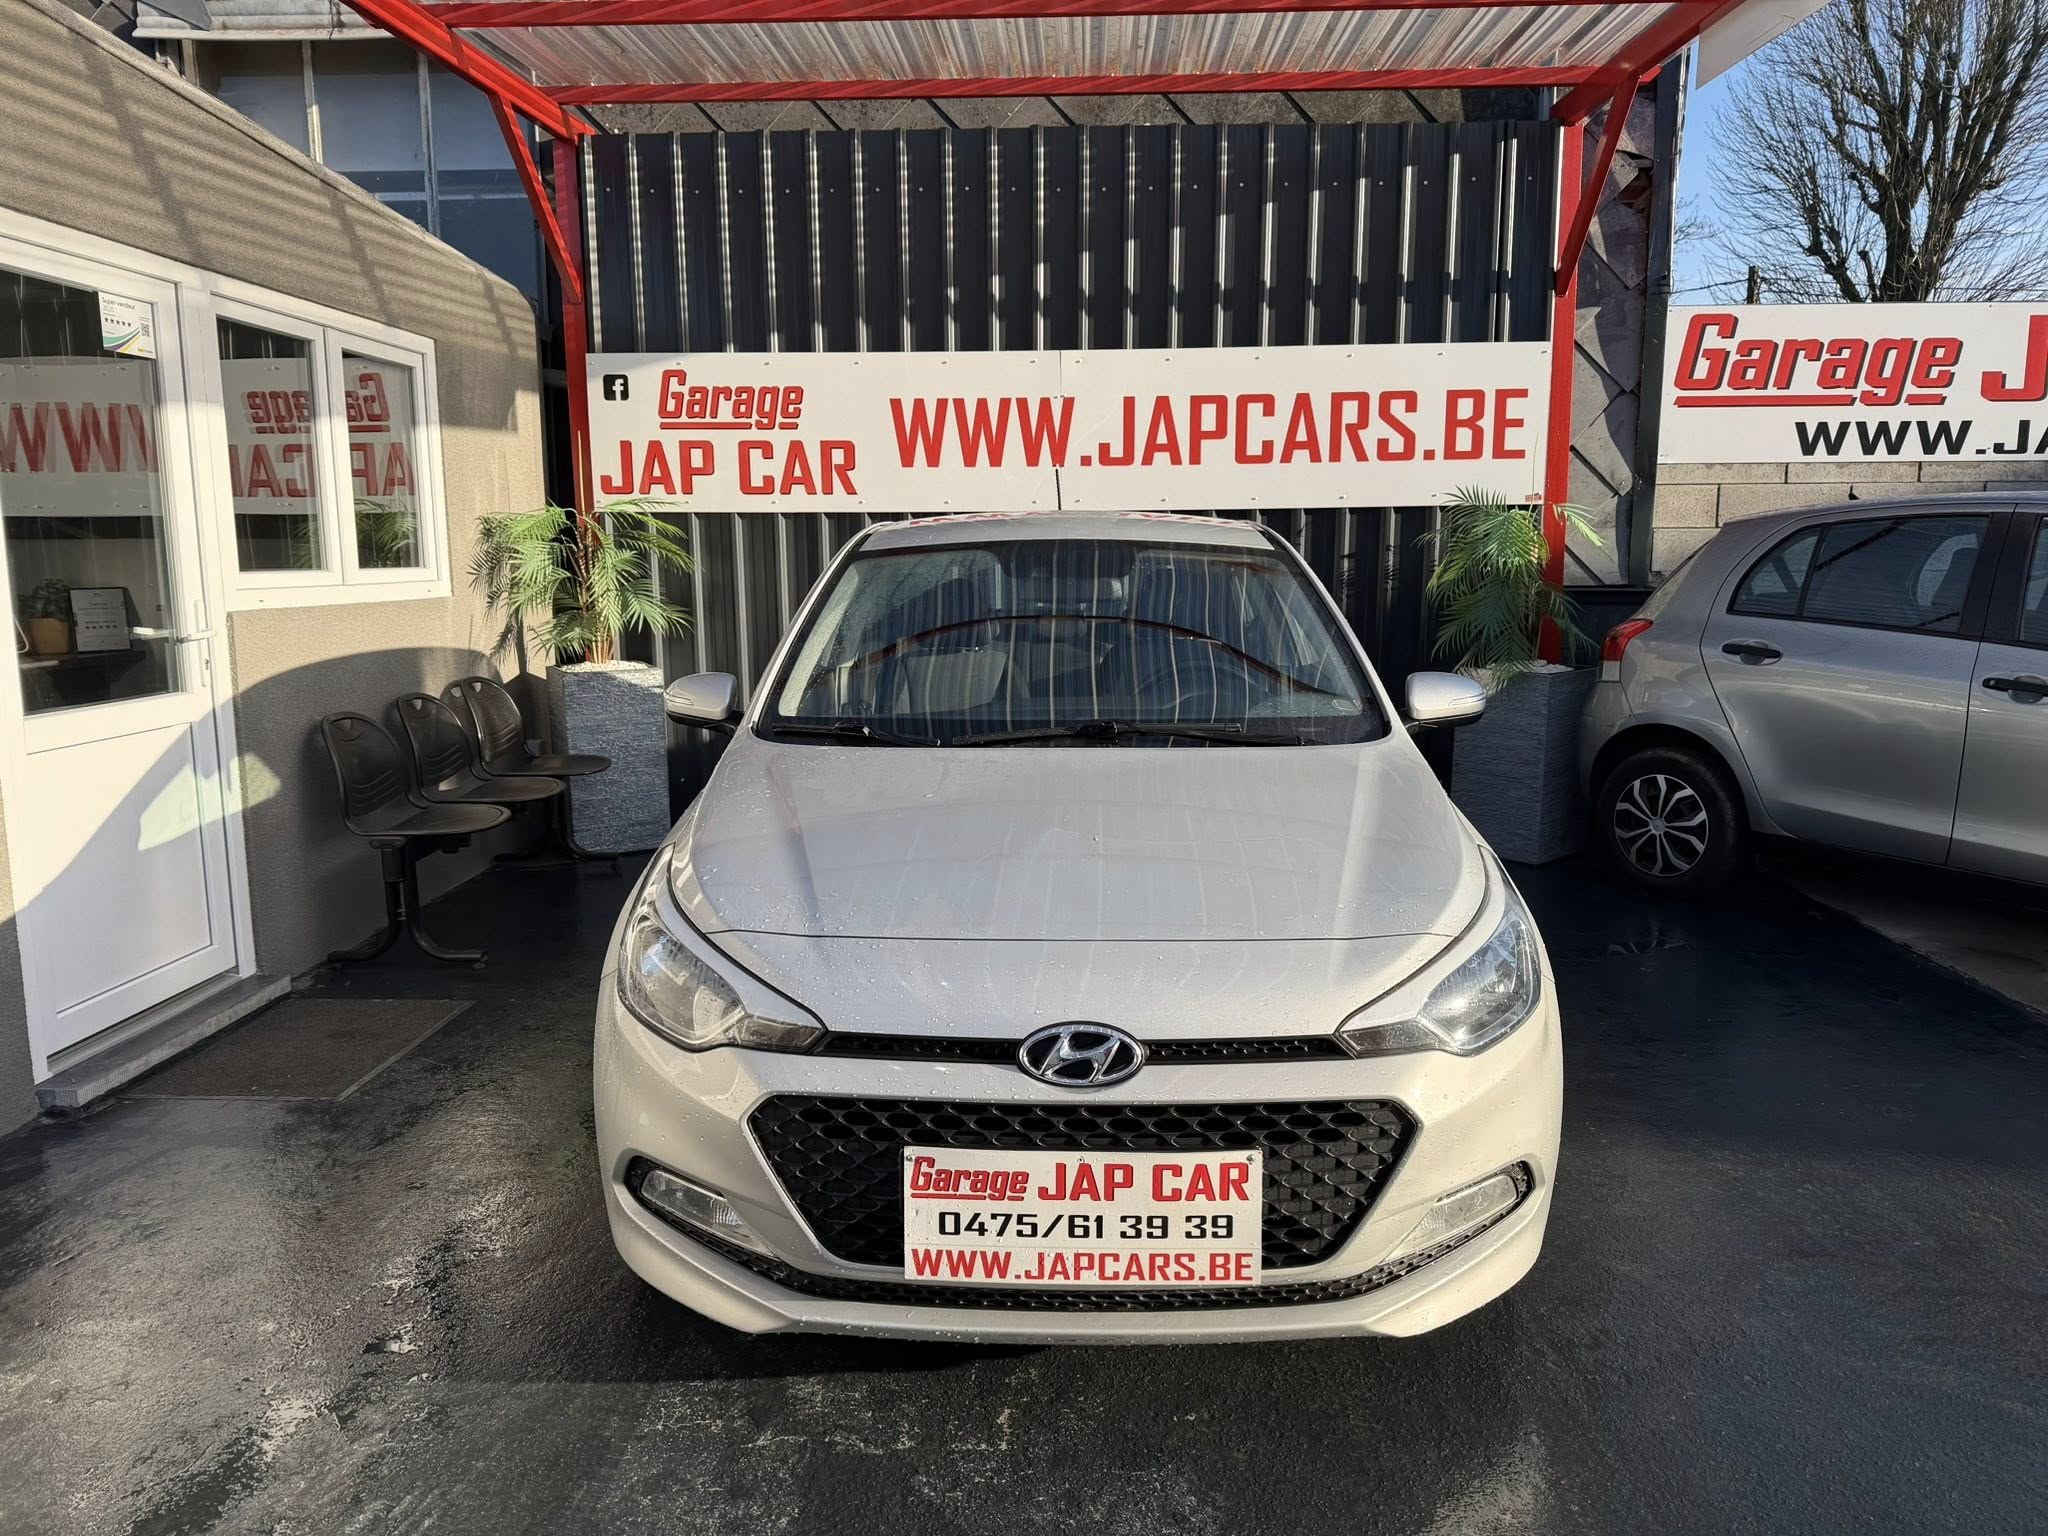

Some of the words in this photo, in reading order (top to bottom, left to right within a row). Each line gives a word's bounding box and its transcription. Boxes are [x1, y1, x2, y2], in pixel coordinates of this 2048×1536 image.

[1674, 313, 1964, 407] Garage
[658, 369, 804, 430] Garage
[889, 388, 1529, 468] WWW.JAPCARS.BE
[600, 439, 715, 495] JAP
[737, 440, 858, 496] CAR
[910, 1156, 1030, 1201] Garage
[1037, 1162, 1134, 1202] JAP
[1151, 1161, 1250, 1202] CAR
[938, 1211, 1104, 1239] 0475/61
[1120, 1215, 1169, 1239] 39
[1184, 1215, 1234, 1239] 39
[912, 1248, 1253, 1281] WWW.JAPCARS.BE
